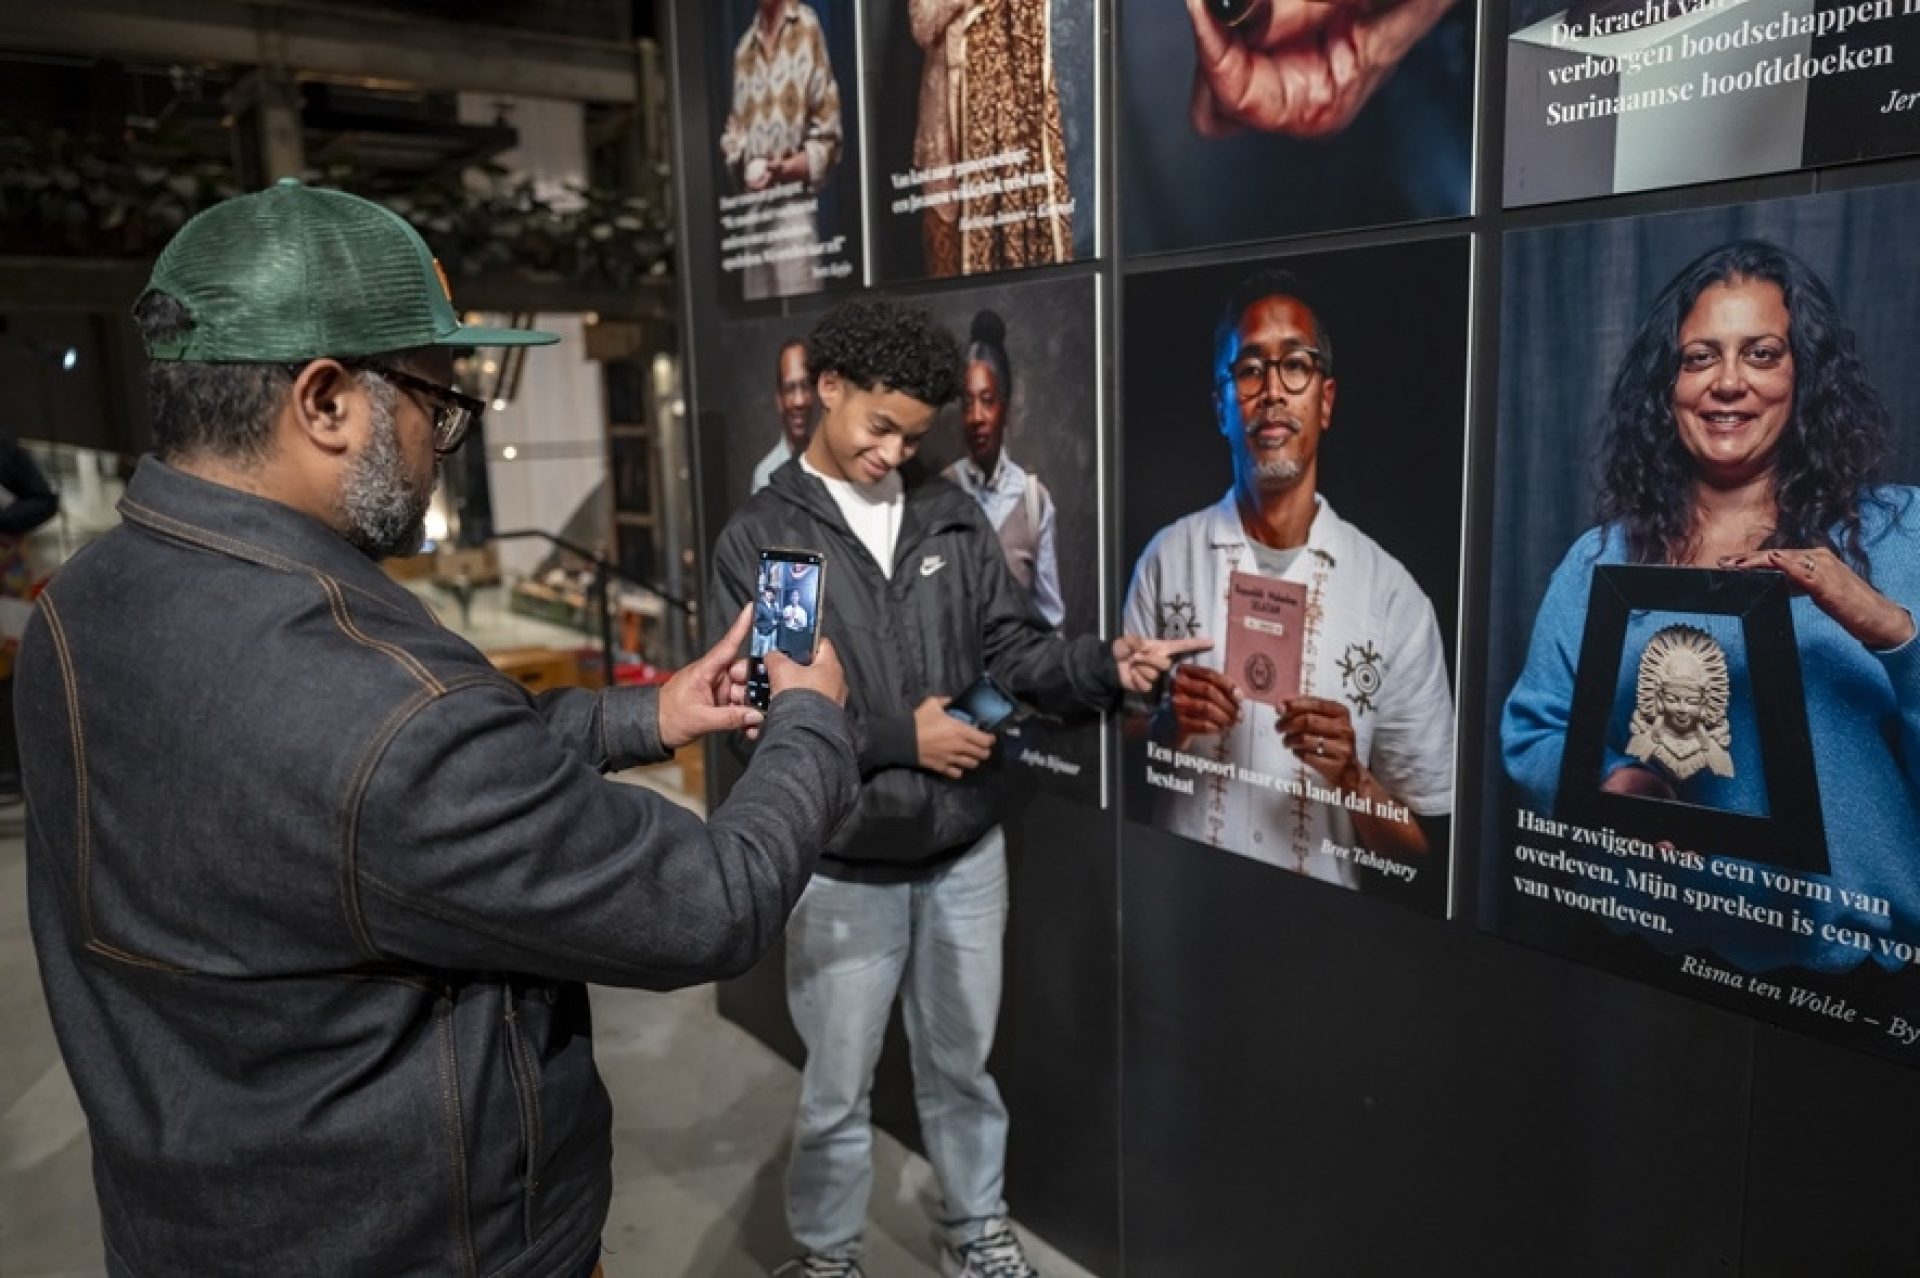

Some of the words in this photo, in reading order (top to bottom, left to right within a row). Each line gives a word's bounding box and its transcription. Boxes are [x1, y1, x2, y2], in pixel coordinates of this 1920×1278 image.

[1548, 44, 1673, 86] verborgen
[1681, 0, 1893, 59] boodschappen
[1551, 23, 1582, 45] De
[1588, 0, 1669, 37] kracht
[1546, 81, 1693, 126] Surinaamse
[1701, 44, 1893, 97] hoofddoeken
[1146, 740, 1173, 762] Een
[1175, 751, 1235, 779] paspoort
[1239, 767, 1271, 787] naar
[1274, 778, 1303, 796] een
[1306, 779, 1342, 806] land
[1345, 790, 1371, 815] dat
[1376, 799, 1408, 825] niet
[1515, 845, 1620, 886] overleven.
[1625, 867, 1678, 901] Mijn
[1683, 887, 1785, 930] spreken
[1791, 909, 1815, 935] is
[1821, 923, 1873, 951] een
[1517, 808, 1569, 838] Haar
[1572, 826, 1654, 860] zwijgen
[1660, 847, 1706, 871] was
[1711, 858, 1755, 884] een
[1761, 870, 1832, 903] vorm
[1840, 887, 1891, 918] van
[1514, 876, 1550, 899] van
[1552, 887, 1674, 934] voortleven.
[1681, 954, 1743, 988] Risma
[1748, 976, 1782, 1000] ten
[1789, 986, 1857, 1023] Wolde
